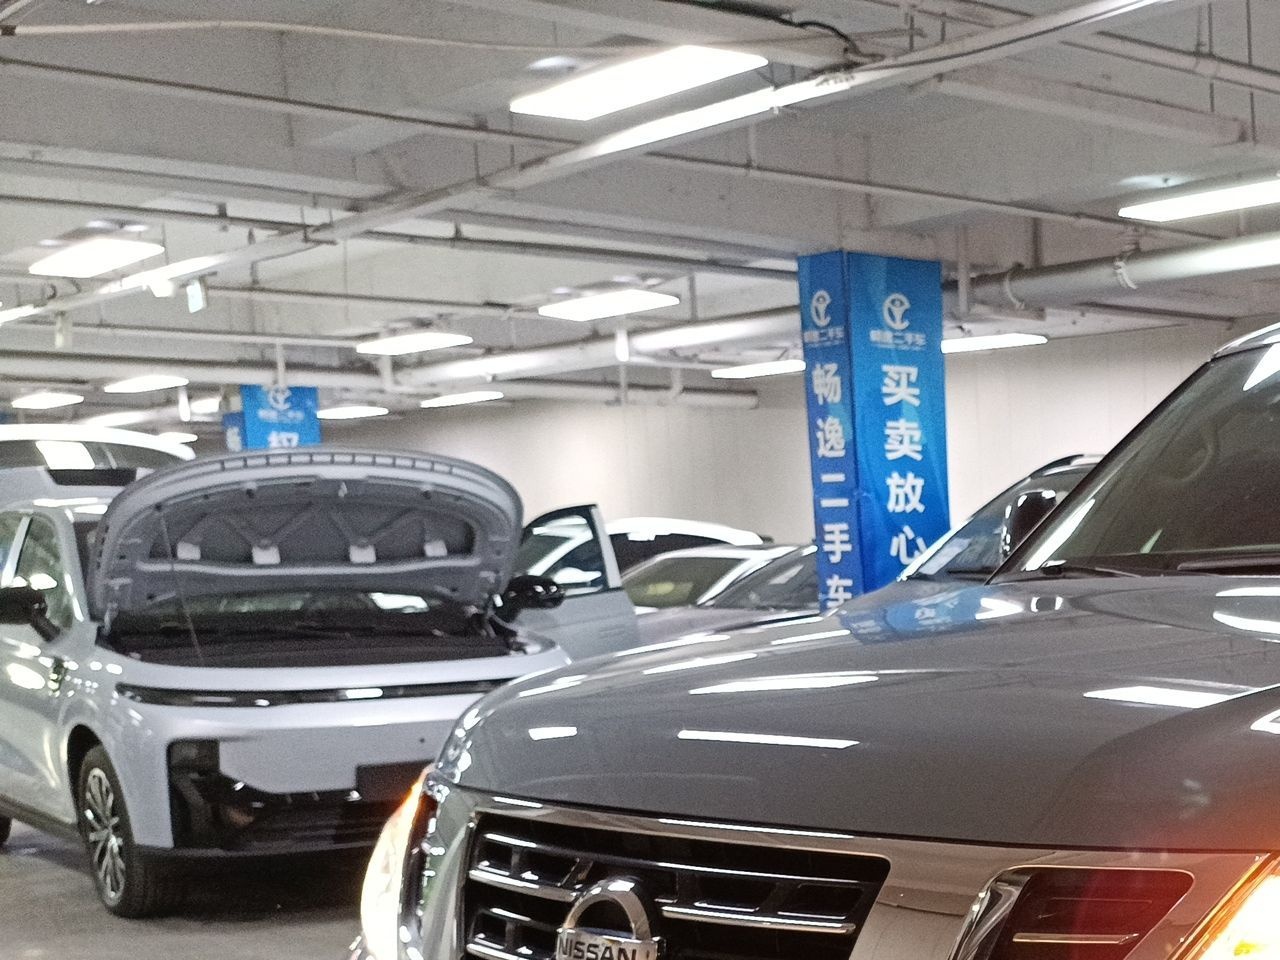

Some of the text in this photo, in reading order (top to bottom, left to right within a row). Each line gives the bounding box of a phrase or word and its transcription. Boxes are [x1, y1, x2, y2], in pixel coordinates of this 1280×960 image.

[811, 363, 853, 608] 畅逸二手车
[881, 364, 927, 566] 买卖放心
